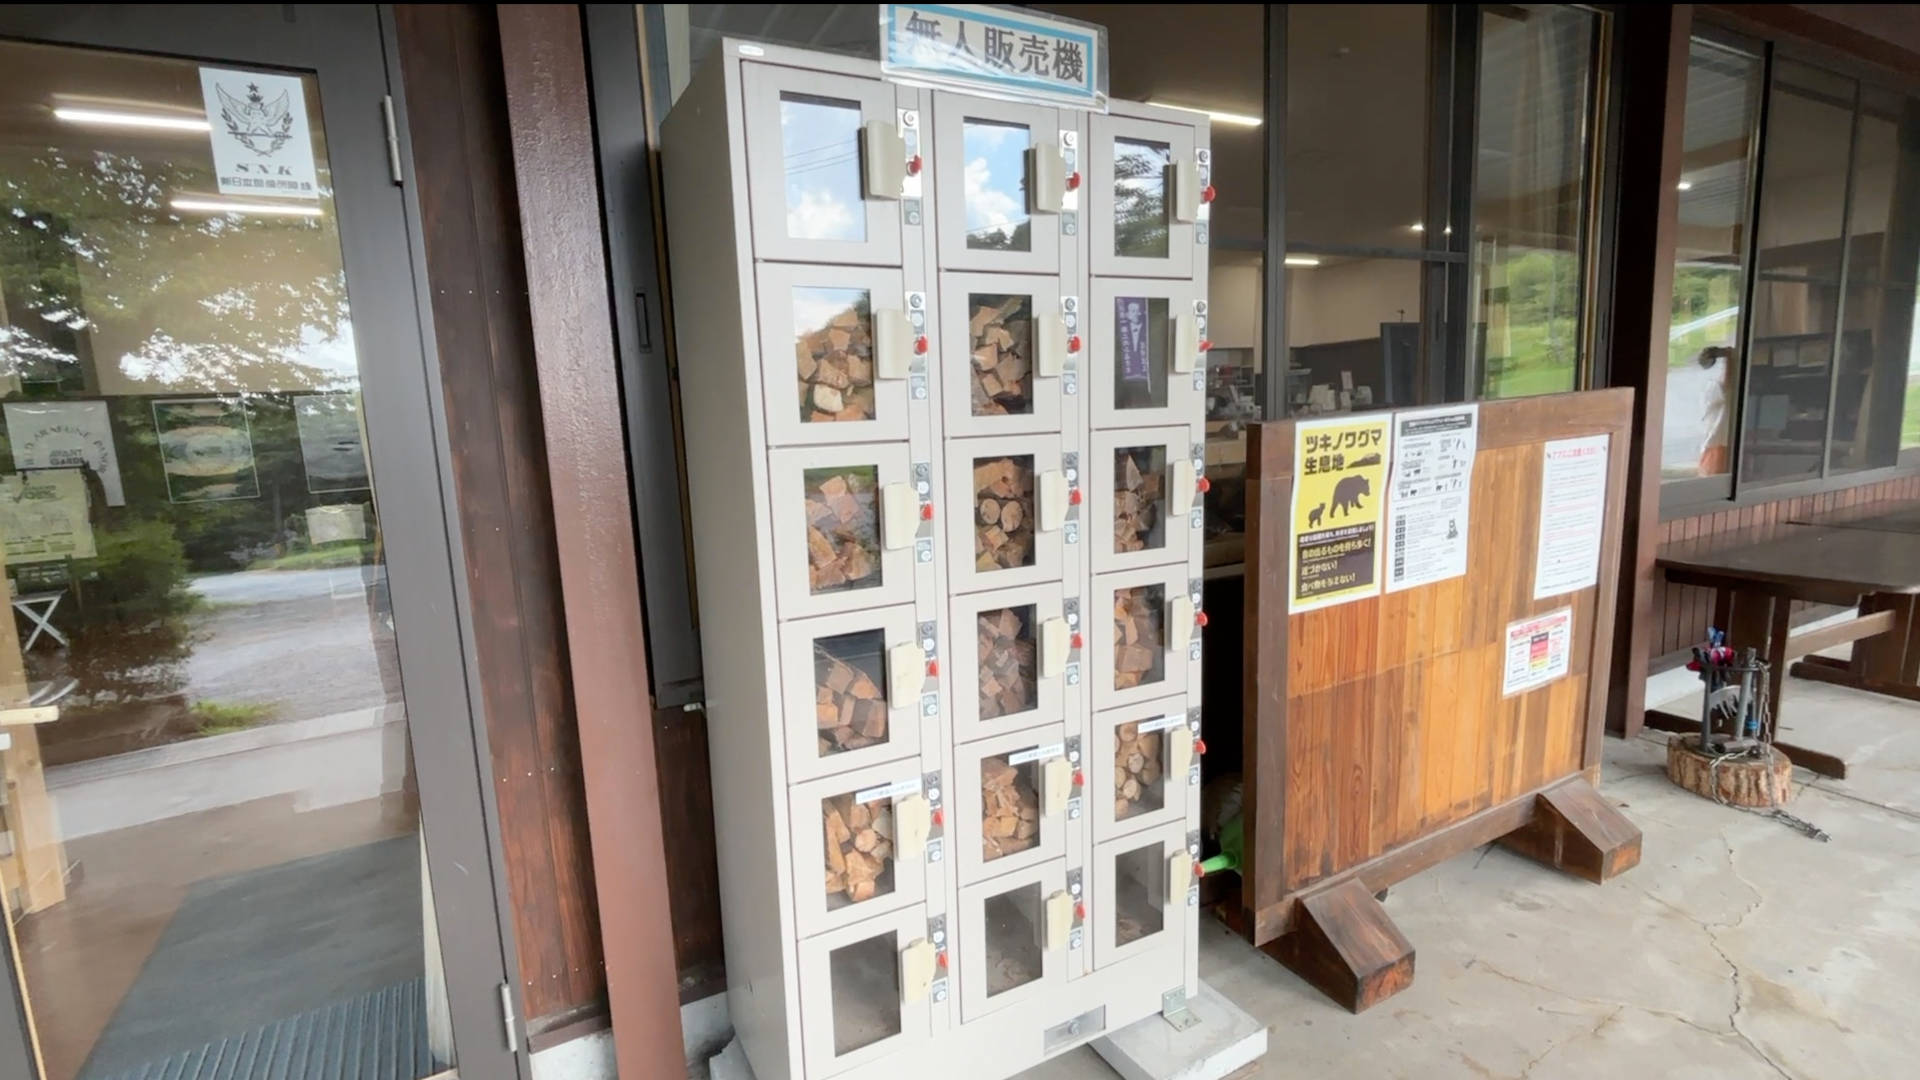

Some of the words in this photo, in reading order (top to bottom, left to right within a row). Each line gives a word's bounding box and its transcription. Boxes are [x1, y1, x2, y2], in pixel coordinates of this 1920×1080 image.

[906, 11, 1083, 82] 無人販売機
[235, 163, 293, 176] SNK
[1306, 429, 1382, 453] ツキノワグマ
[1304, 454, 1345, 475] 生息地
